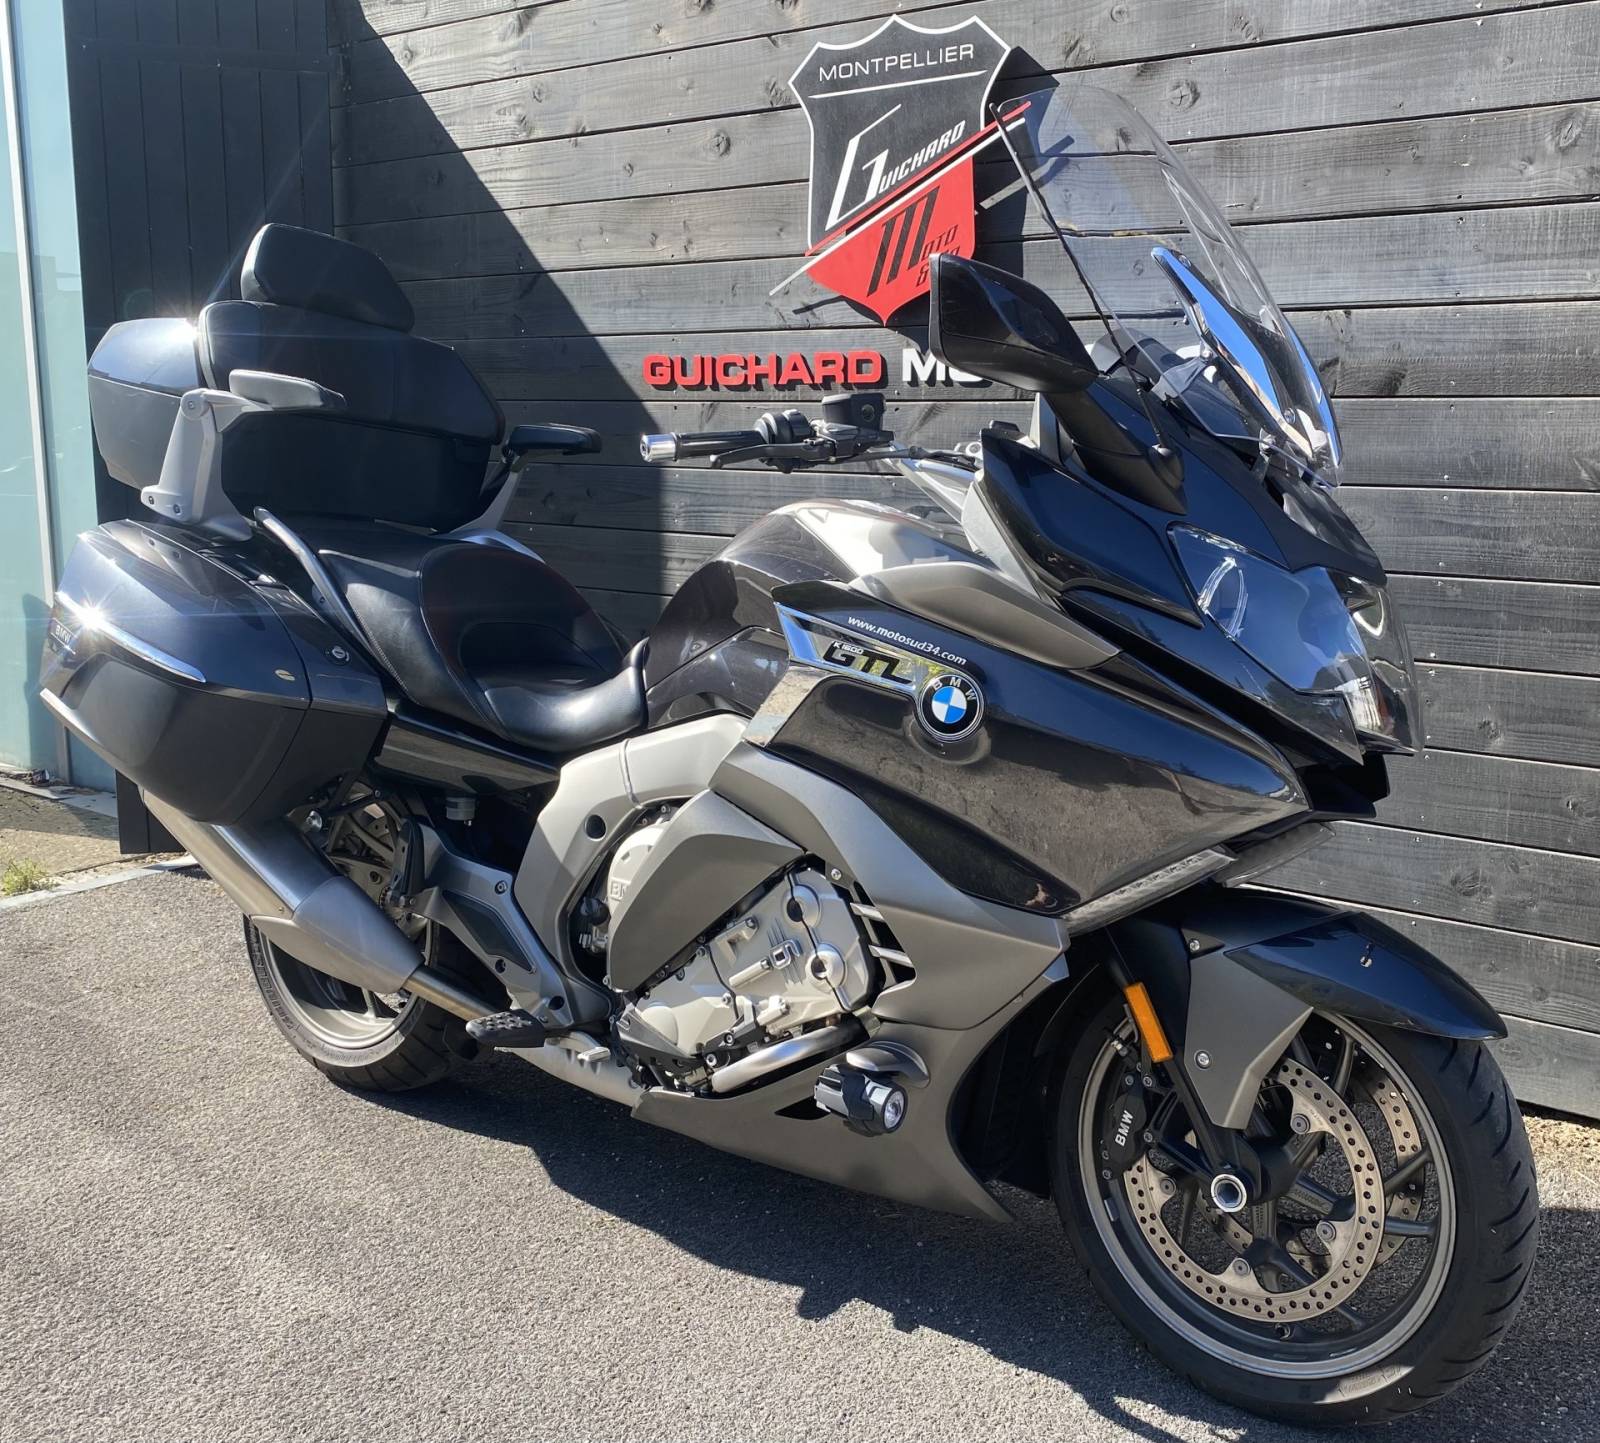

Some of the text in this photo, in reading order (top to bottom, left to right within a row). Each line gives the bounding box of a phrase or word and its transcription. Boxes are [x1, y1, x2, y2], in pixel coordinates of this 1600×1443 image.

[819, 43, 975, 82] MONTPELLIER
[642, 349, 883, 386] GUICHARD
[847, 616, 967, 666] www.motosud34.com
[823, 641, 913, 684] GTL
[932, 676, 977, 701] BMW
[1114, 1110, 1133, 1147] BMW
